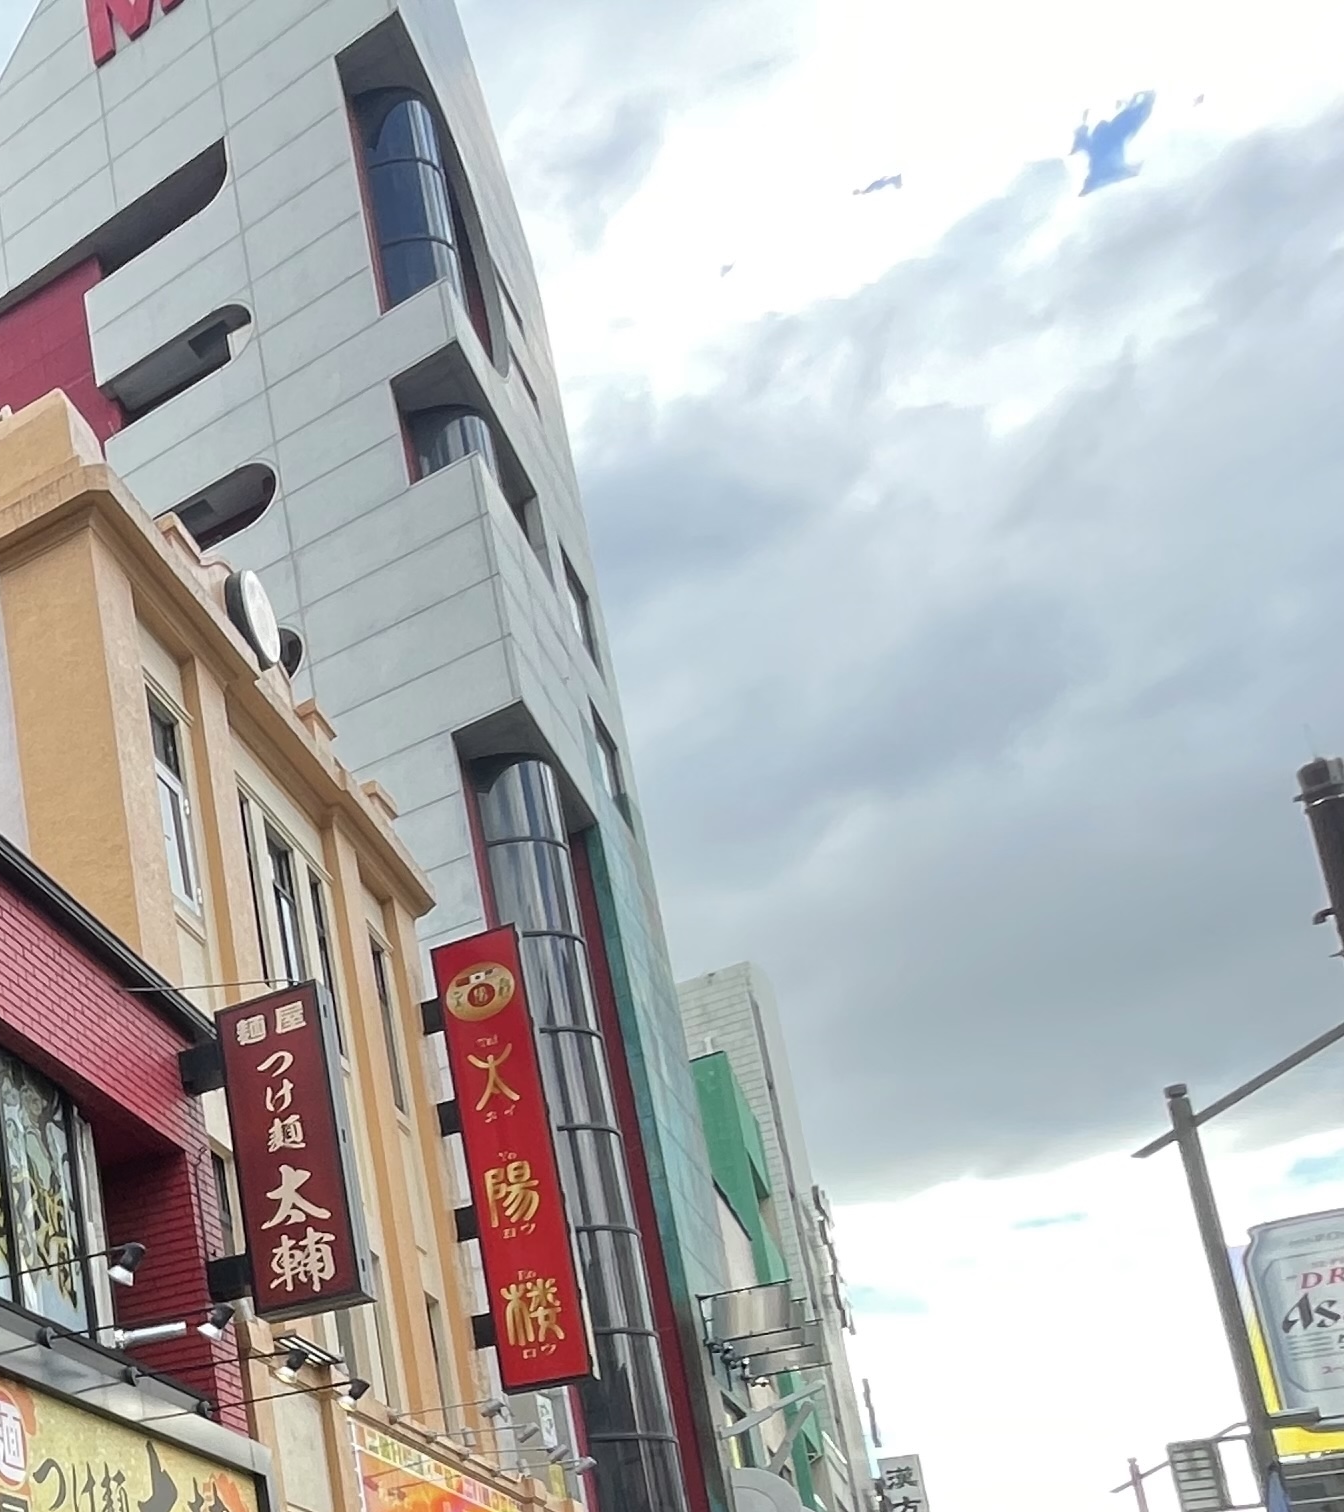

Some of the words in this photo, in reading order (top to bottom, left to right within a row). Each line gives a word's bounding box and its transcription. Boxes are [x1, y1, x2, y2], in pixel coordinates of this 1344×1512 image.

[236, 1001, 307, 1046] 麺屋
[257, 1050, 307, 1153] つけ麺
[262, 1164, 337, 1293] 太輔
